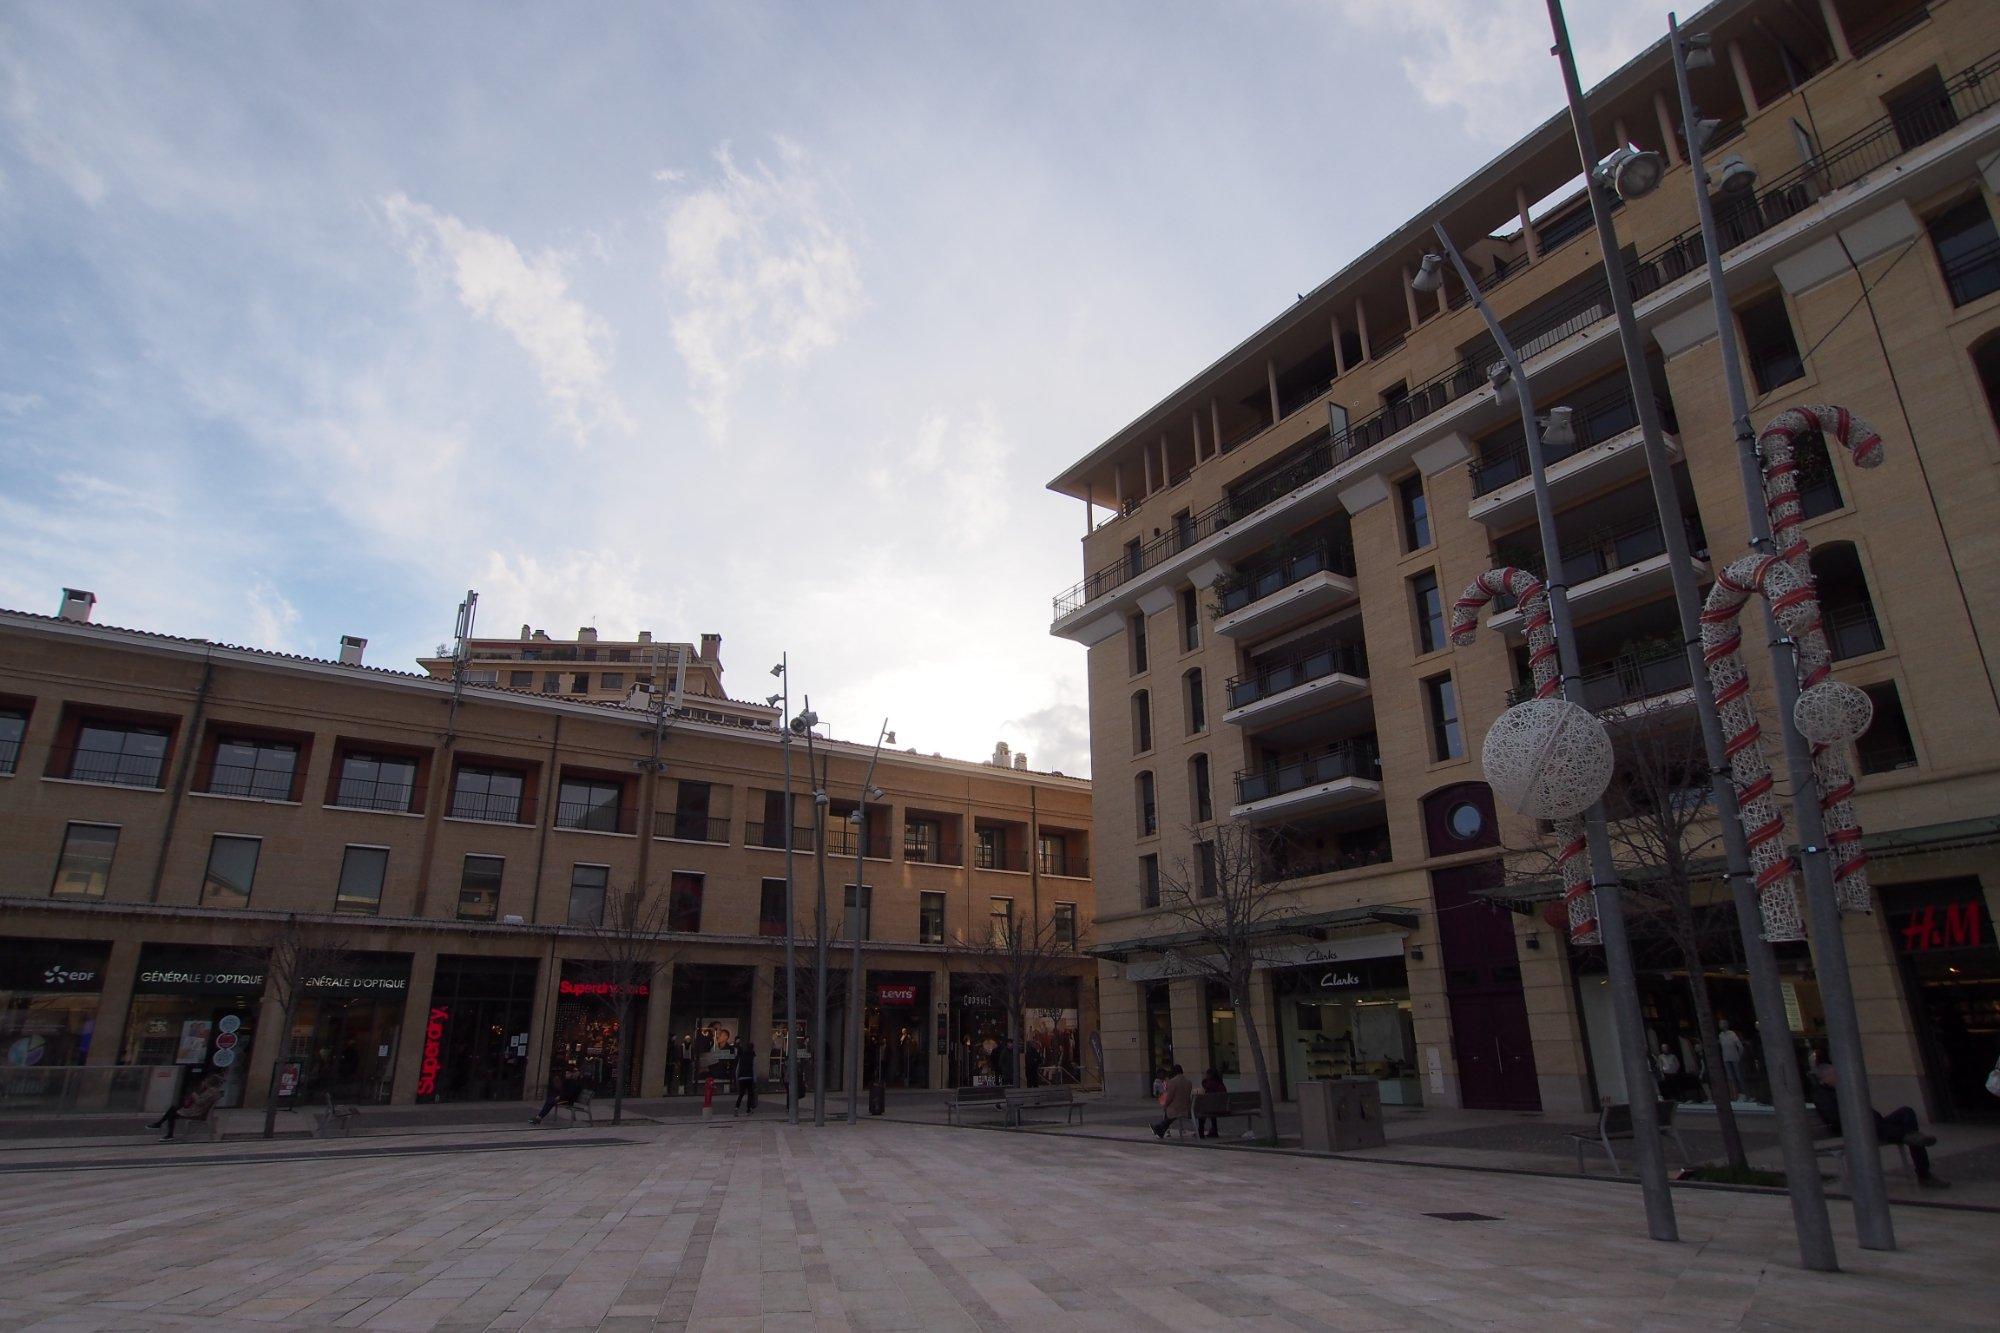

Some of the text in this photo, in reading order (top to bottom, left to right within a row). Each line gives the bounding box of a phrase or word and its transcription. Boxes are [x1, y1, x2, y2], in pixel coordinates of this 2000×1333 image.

[1900, 900, 1981, 952] H&M
[1306, 949, 1336, 962] Clarks
[204, 973, 263, 985] D'OPTIQUE
[353, 978, 406, 989] D'OPTIQUE
[1320, 972, 1360, 987] Clarks
